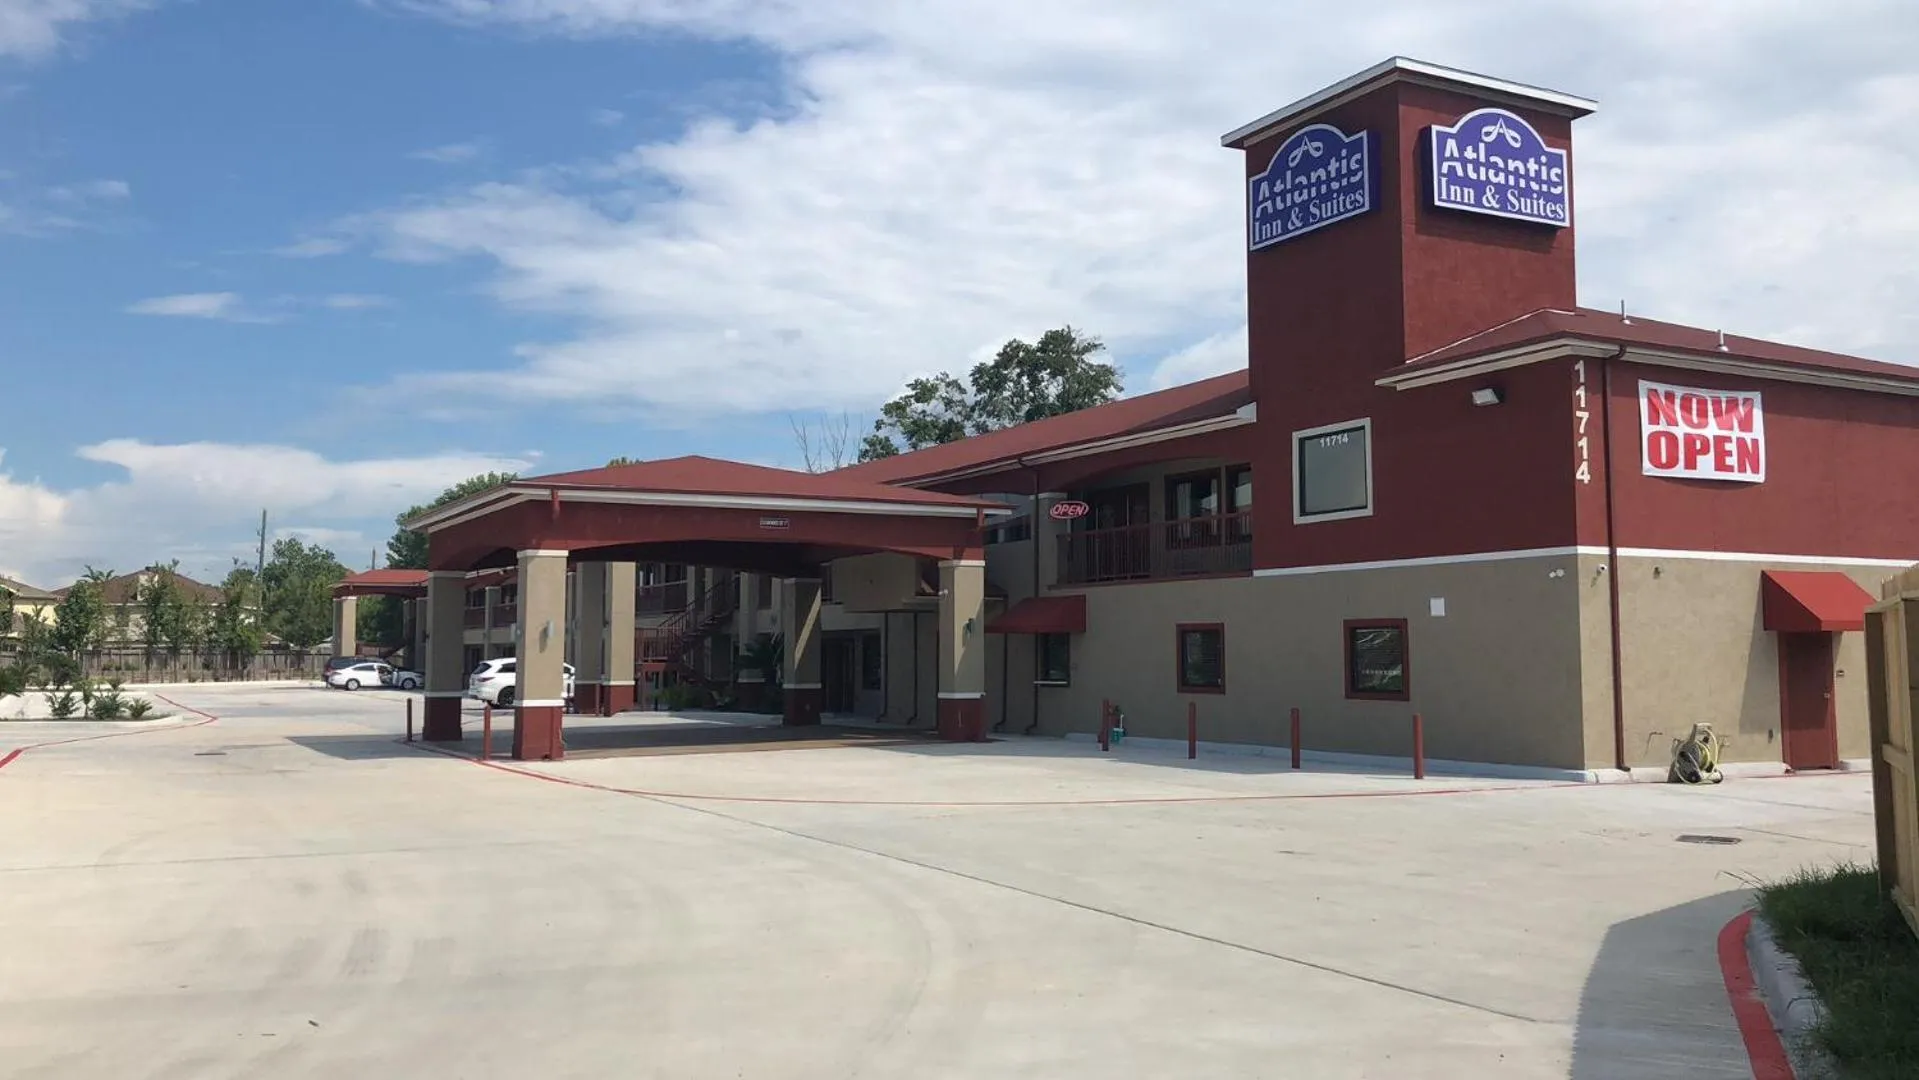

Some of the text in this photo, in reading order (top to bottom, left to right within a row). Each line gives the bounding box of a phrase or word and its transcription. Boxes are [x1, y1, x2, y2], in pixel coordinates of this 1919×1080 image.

[1254, 189, 1364, 243] Inn & Suites
[1440, 176, 1564, 219] Inn & Suites
[1574, 359, 1591, 484] 11714
[1646, 388, 1755, 433] NOW
[1319, 432, 1349, 448] 11714
[1647, 430, 1760, 475] OPEN
[1052, 504, 1085, 516] OPEN
